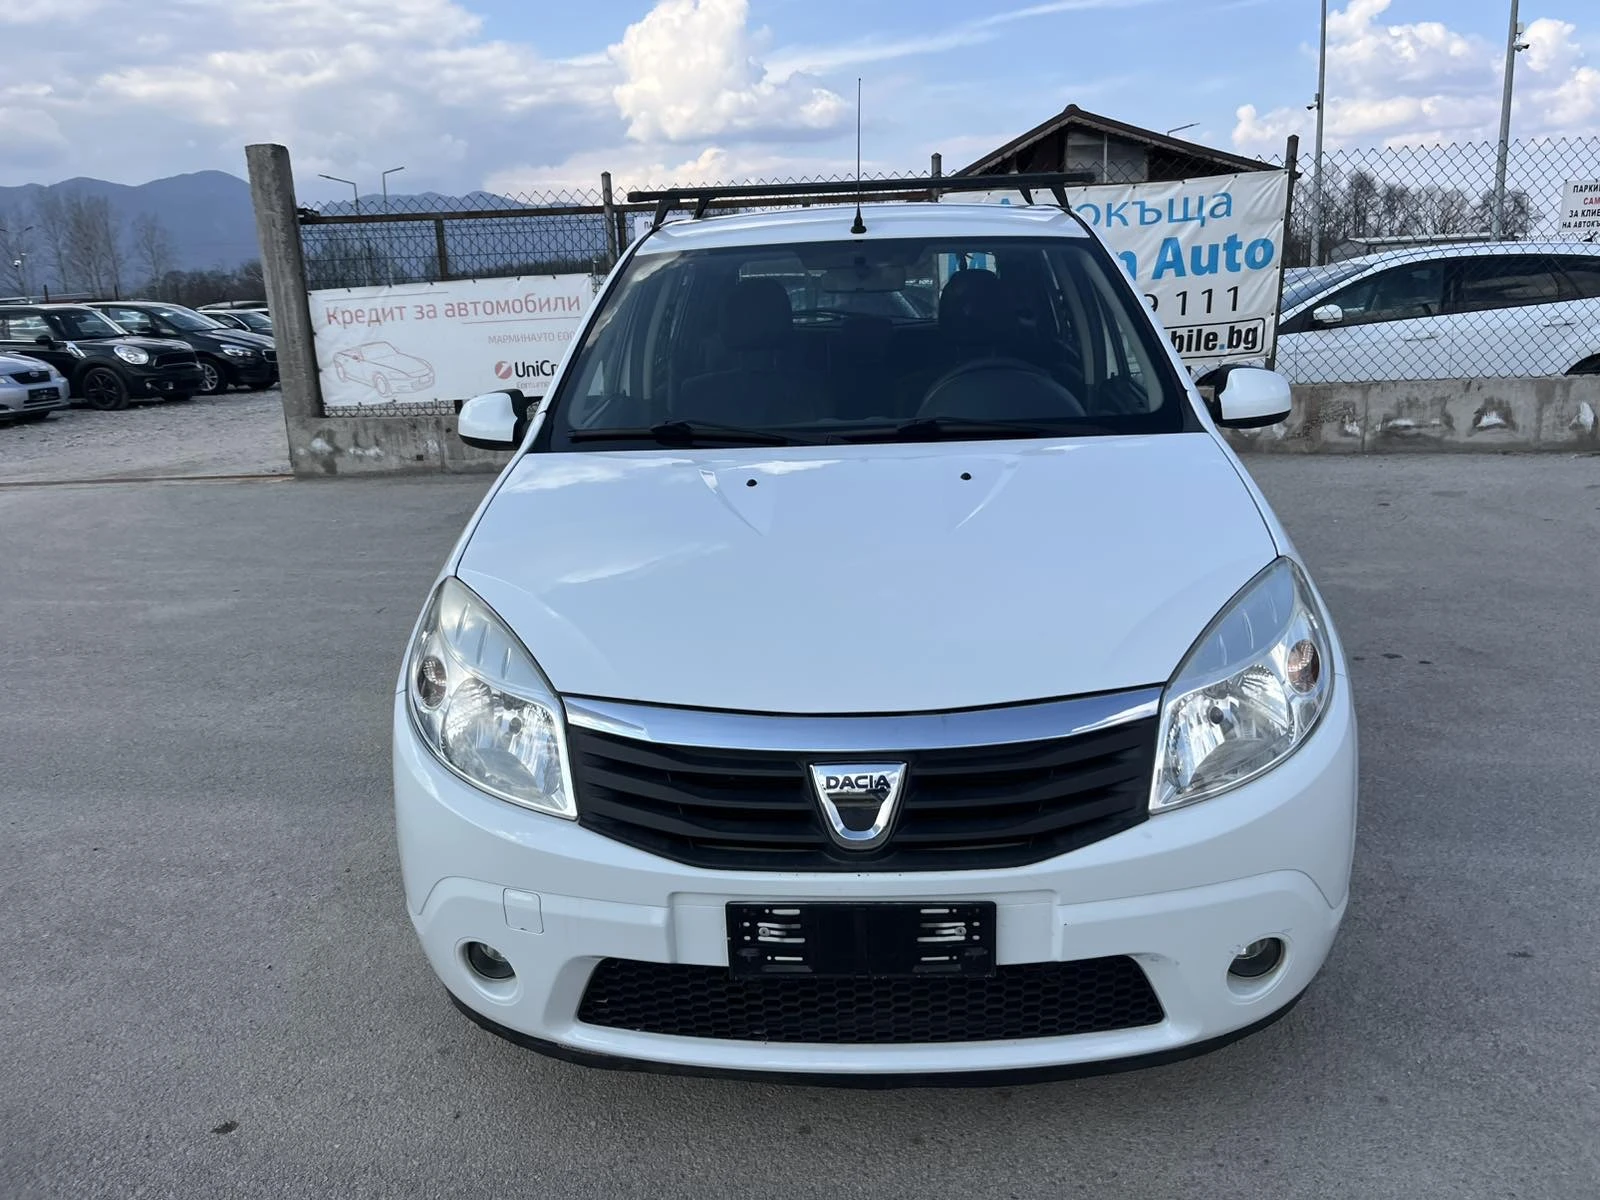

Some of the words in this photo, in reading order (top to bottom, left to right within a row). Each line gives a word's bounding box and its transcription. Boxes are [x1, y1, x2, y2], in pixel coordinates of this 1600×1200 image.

[1573, 184, 1600, 193] ПАРКИ
[1569, 210, 1579, 218] ЗА
[1562, 221, 1571, 229] НА
[1151, 233, 1275, 280] Auto
[326, 305, 407, 329] Кредит
[414, 303, 438, 320] за
[444, 293, 580, 318] автомобили
[515, 360, 559, 378] UniCr
[825, 775, 891, 790] DACIA
